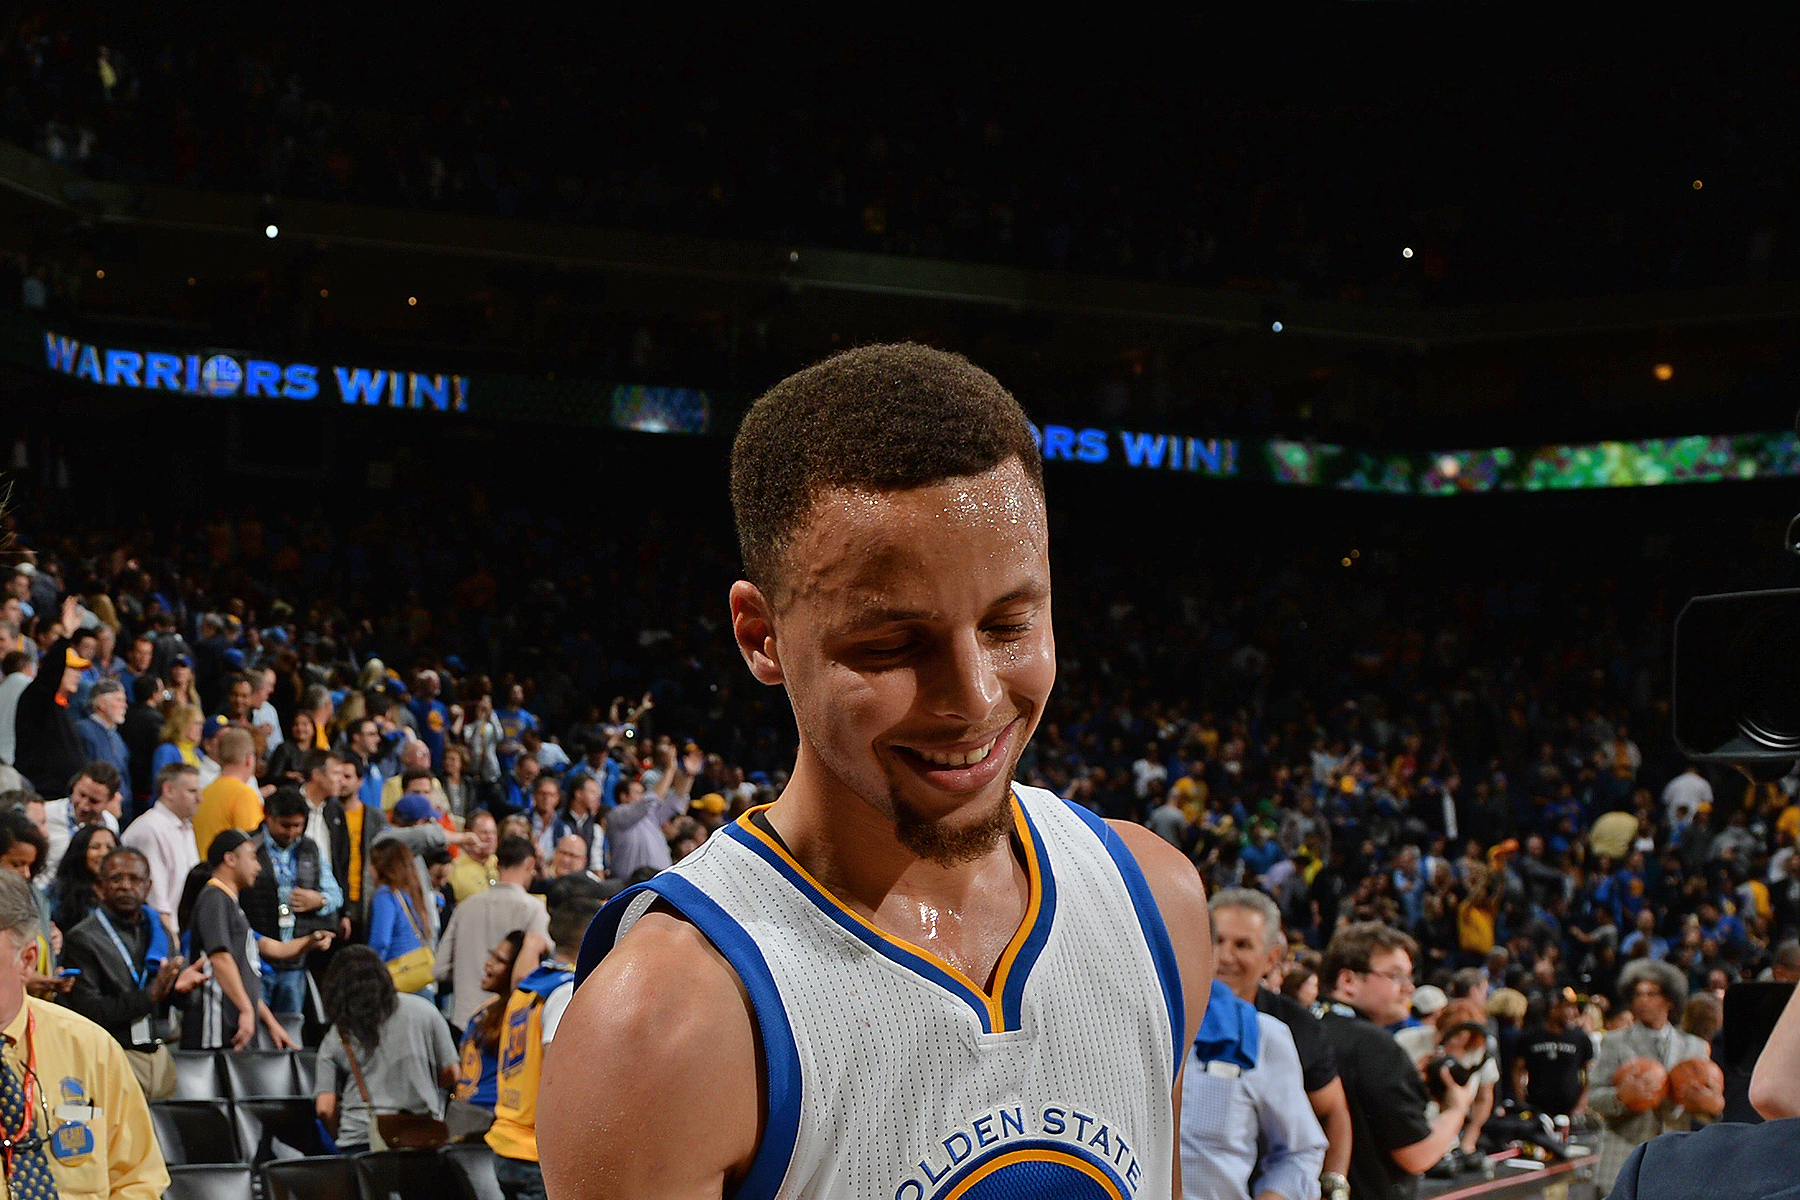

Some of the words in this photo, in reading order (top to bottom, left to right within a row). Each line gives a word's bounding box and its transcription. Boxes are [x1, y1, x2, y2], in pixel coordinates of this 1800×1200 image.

[333, 365, 470, 412] WIN!
[1027, 421, 1110, 464] RS
[1120, 429, 1240, 475] WIN!
[1042, 1107, 1144, 1194] STATE
